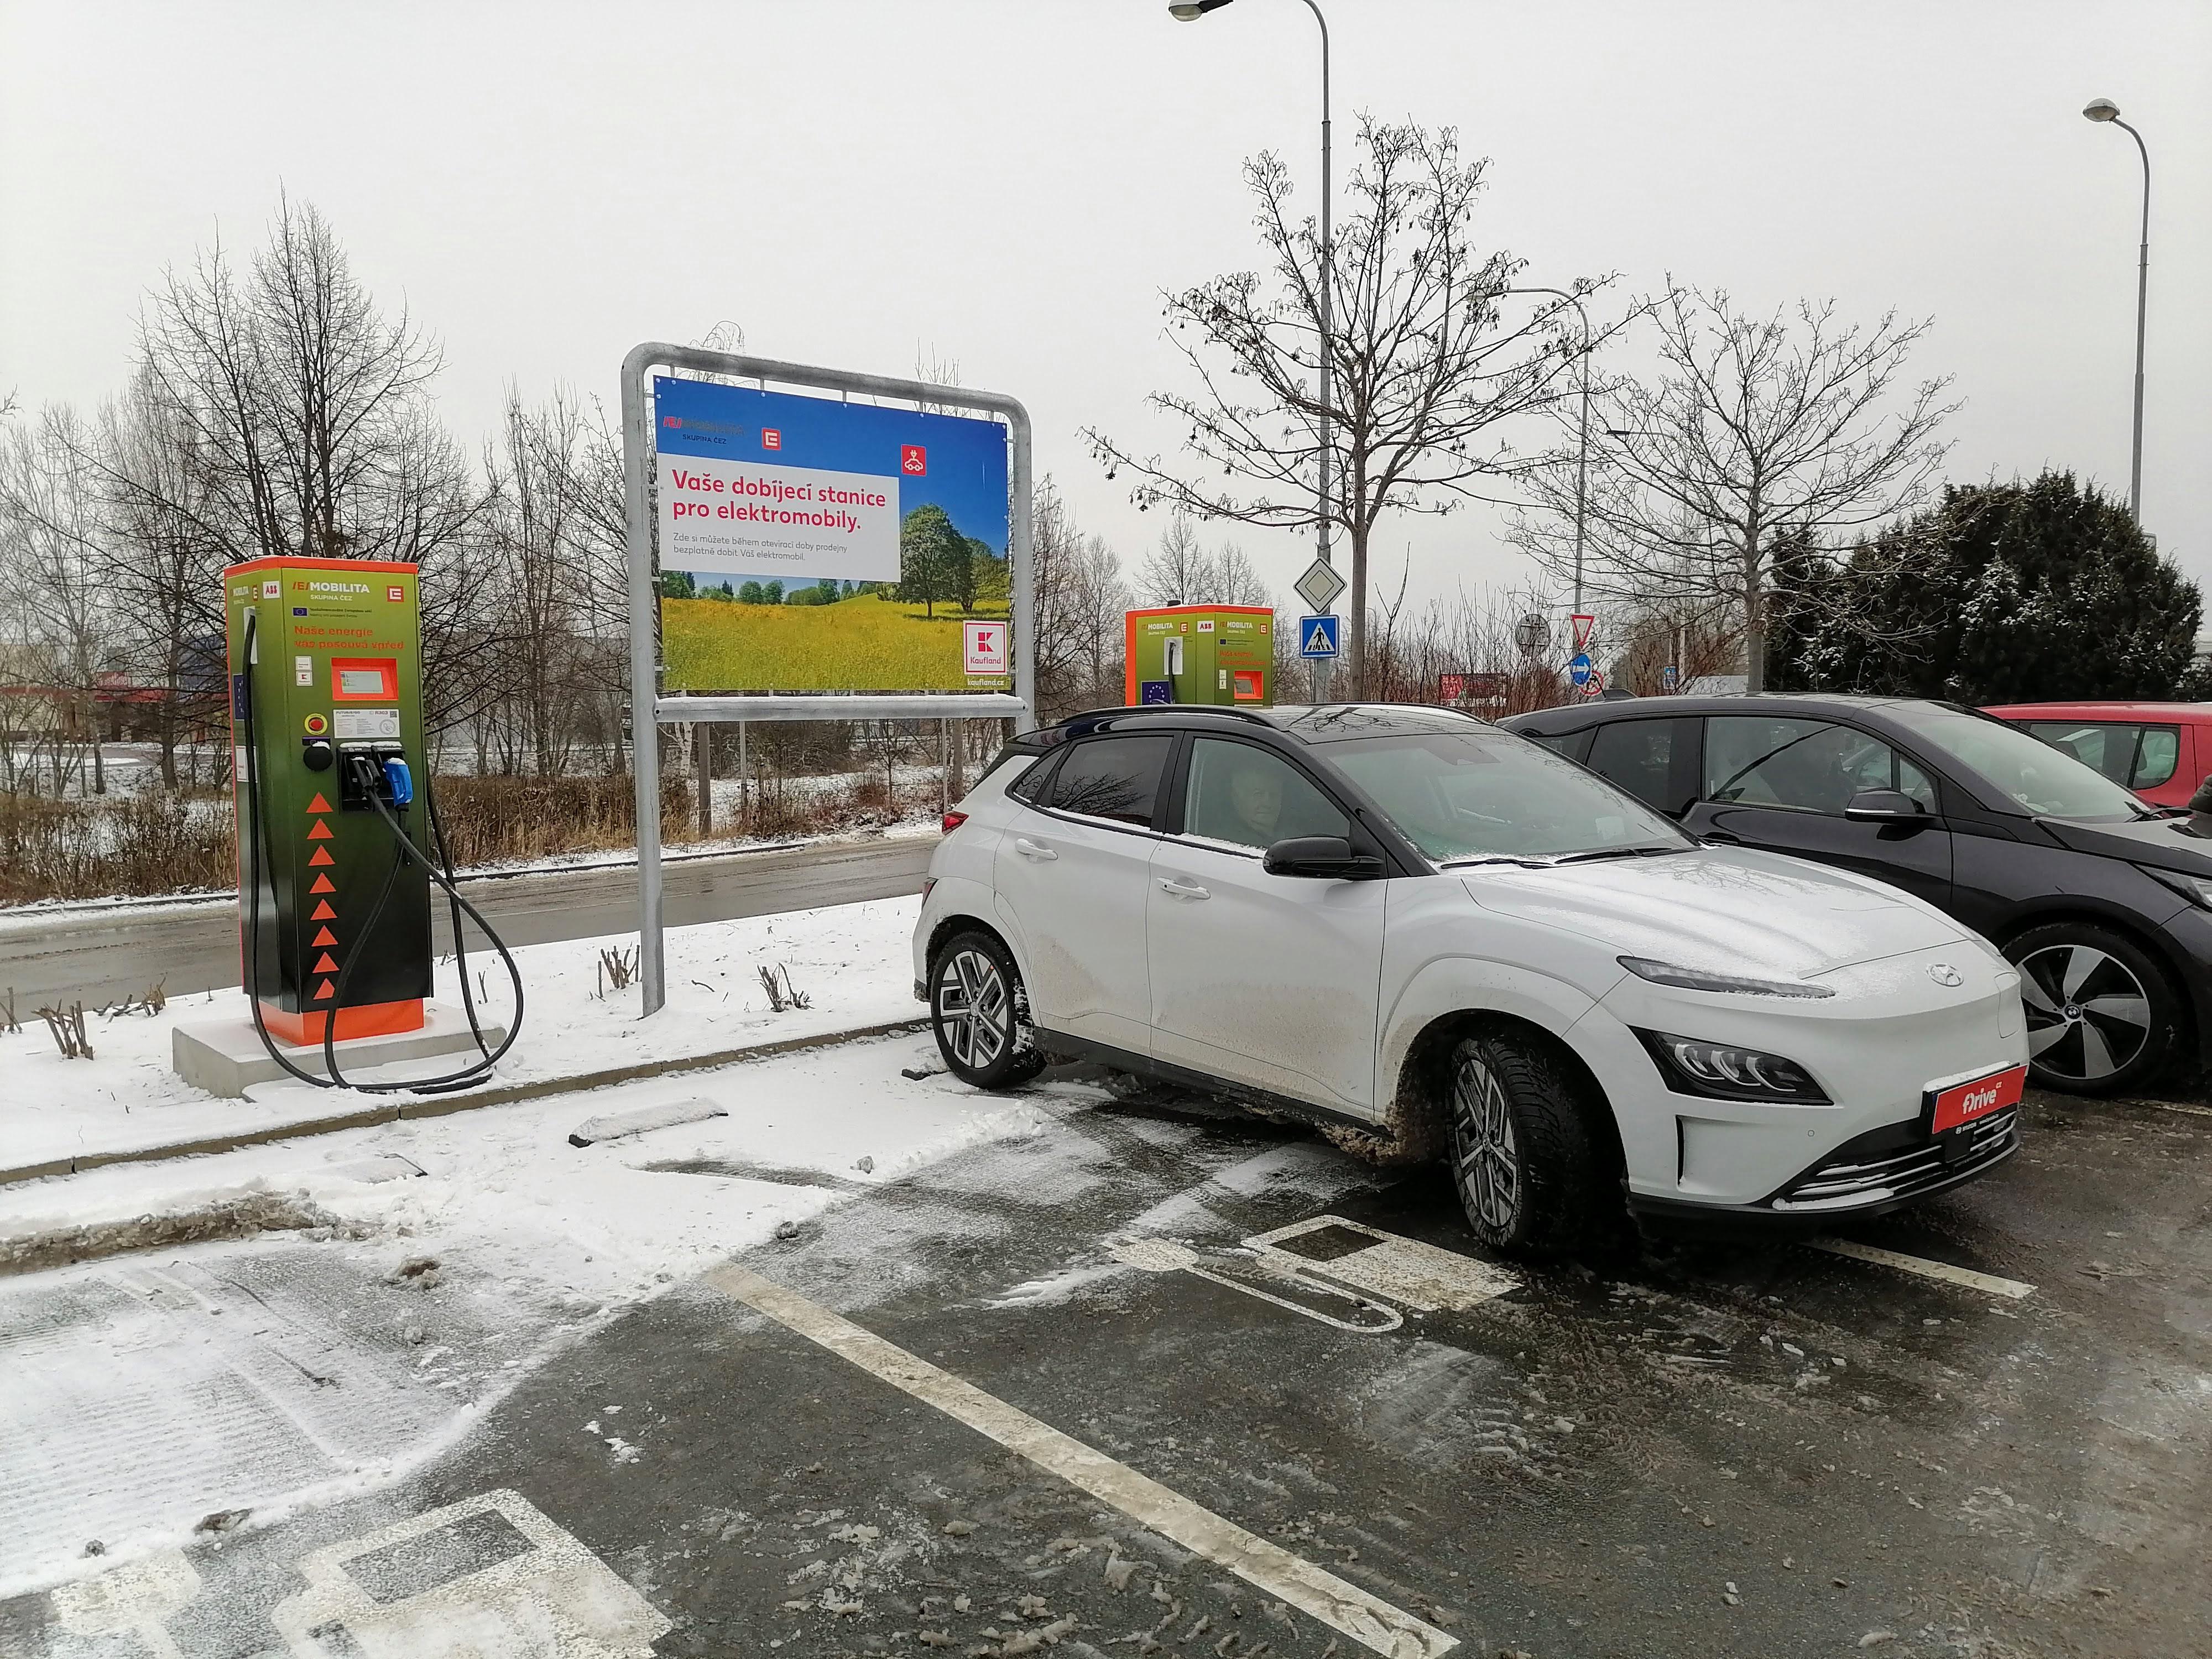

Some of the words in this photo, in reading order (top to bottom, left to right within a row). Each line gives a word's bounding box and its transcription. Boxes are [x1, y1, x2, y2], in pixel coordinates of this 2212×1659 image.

[682, 434, 712, 443] SKUPINA
[713, 436, 727, 444] ČEZ
[672, 469, 724, 492] Vaše
[732, 476, 812, 503] dobíjecí
[818, 486, 885, 507] stanice
[673, 502, 709, 520] pro
[717, 501, 860, 533] elektromobily.
[673, 533, 689, 541] Zde
[700, 535, 730, 544] můžete
[732, 537, 759, 546] během
[796, 541, 814, 551] doby
[816, 544, 847, 553] prodejny
[674, 545, 714, 555] bezplatně
[757, 550, 805, 561] elektromobil.
[265, 585, 278, 594] ABB
[294, 625, 325, 635] Naše
[328, 628, 373, 638] energie
